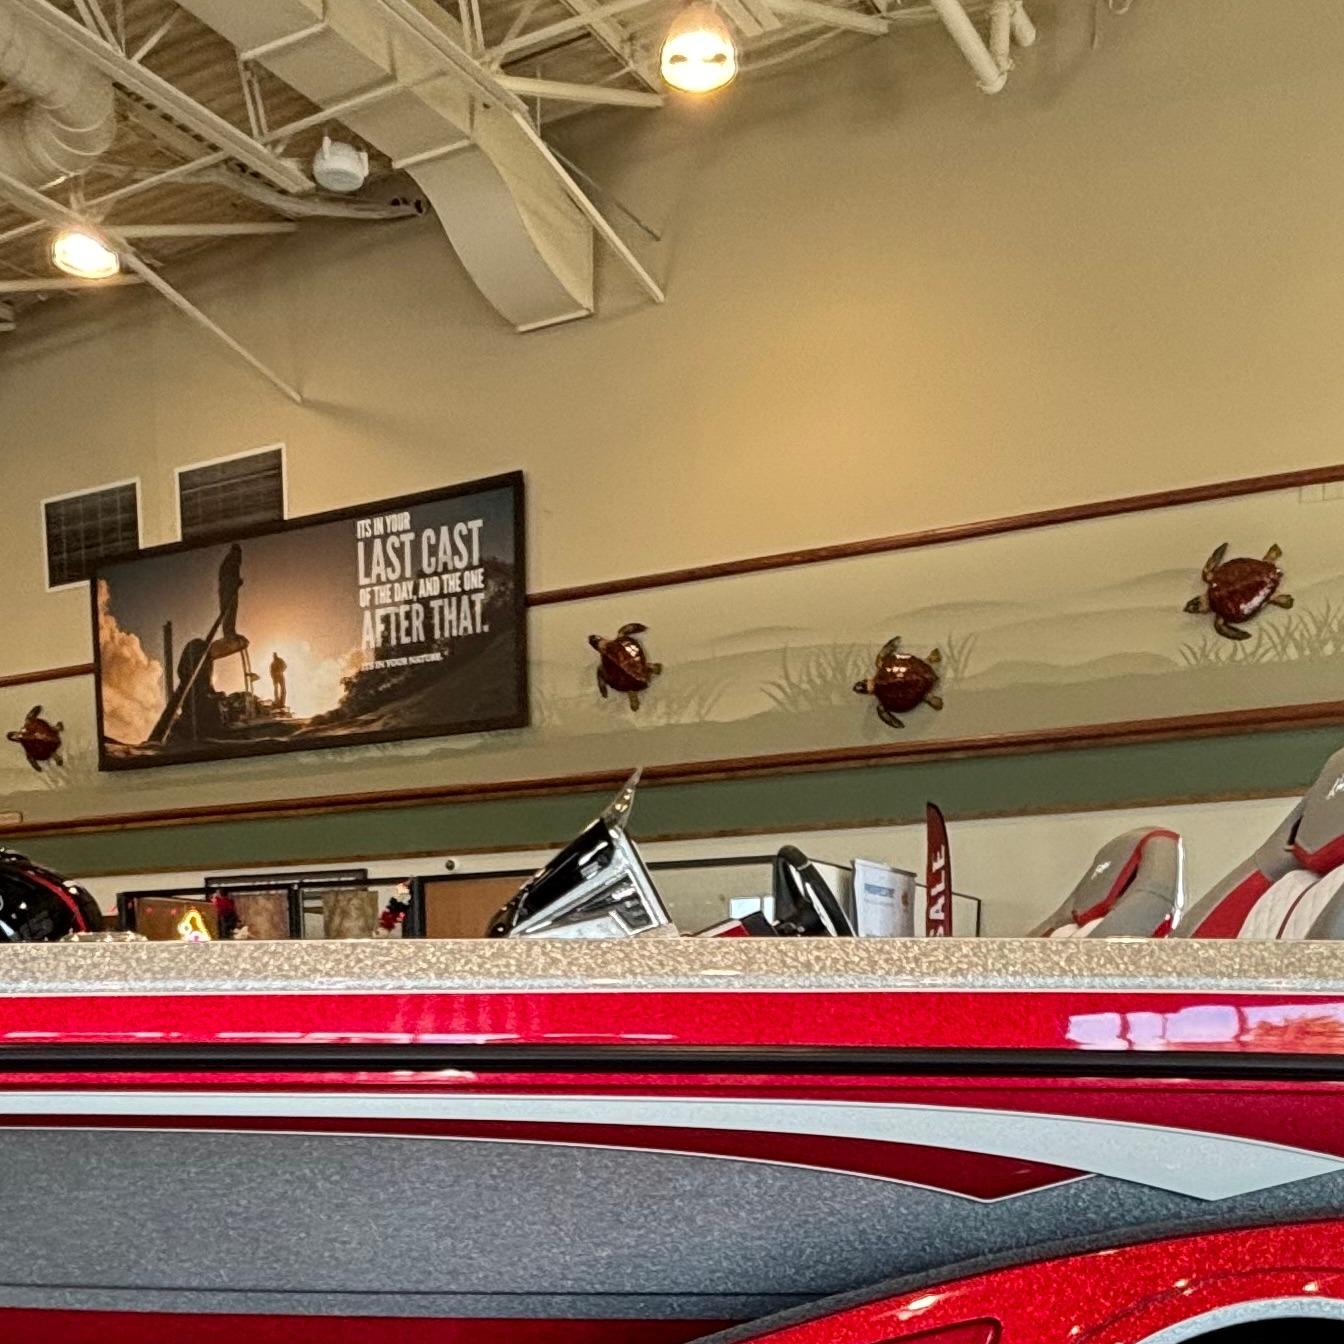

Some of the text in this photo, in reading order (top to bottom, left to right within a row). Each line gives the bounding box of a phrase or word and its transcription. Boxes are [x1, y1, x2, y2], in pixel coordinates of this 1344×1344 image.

[373, 516, 385, 536] IN
[385, 511, 411, 533] YOUR
[357, 519, 483, 586] LAST CAST
[359, 568, 485, 608] OF THE DAY, AND THE ONE
[361, 592, 489, 650] AFTER THAT.
